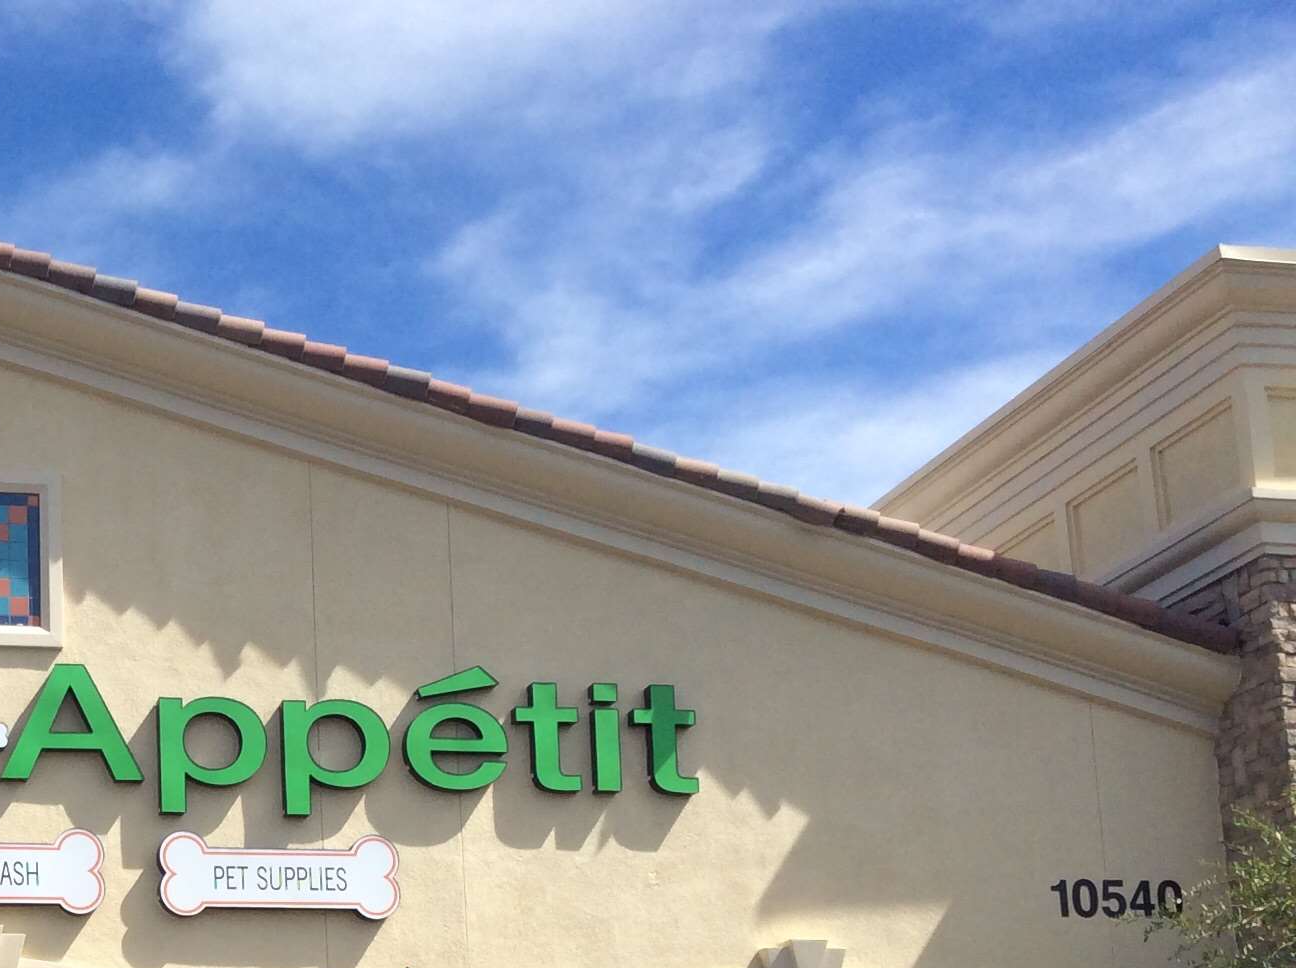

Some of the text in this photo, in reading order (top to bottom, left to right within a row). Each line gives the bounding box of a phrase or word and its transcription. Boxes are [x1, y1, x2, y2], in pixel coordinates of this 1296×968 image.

[0, 664, 700, 818] Appétit
[213, 865, 348, 892] PET SUPPLIES
[1050, 878, 1183, 919] 10540
